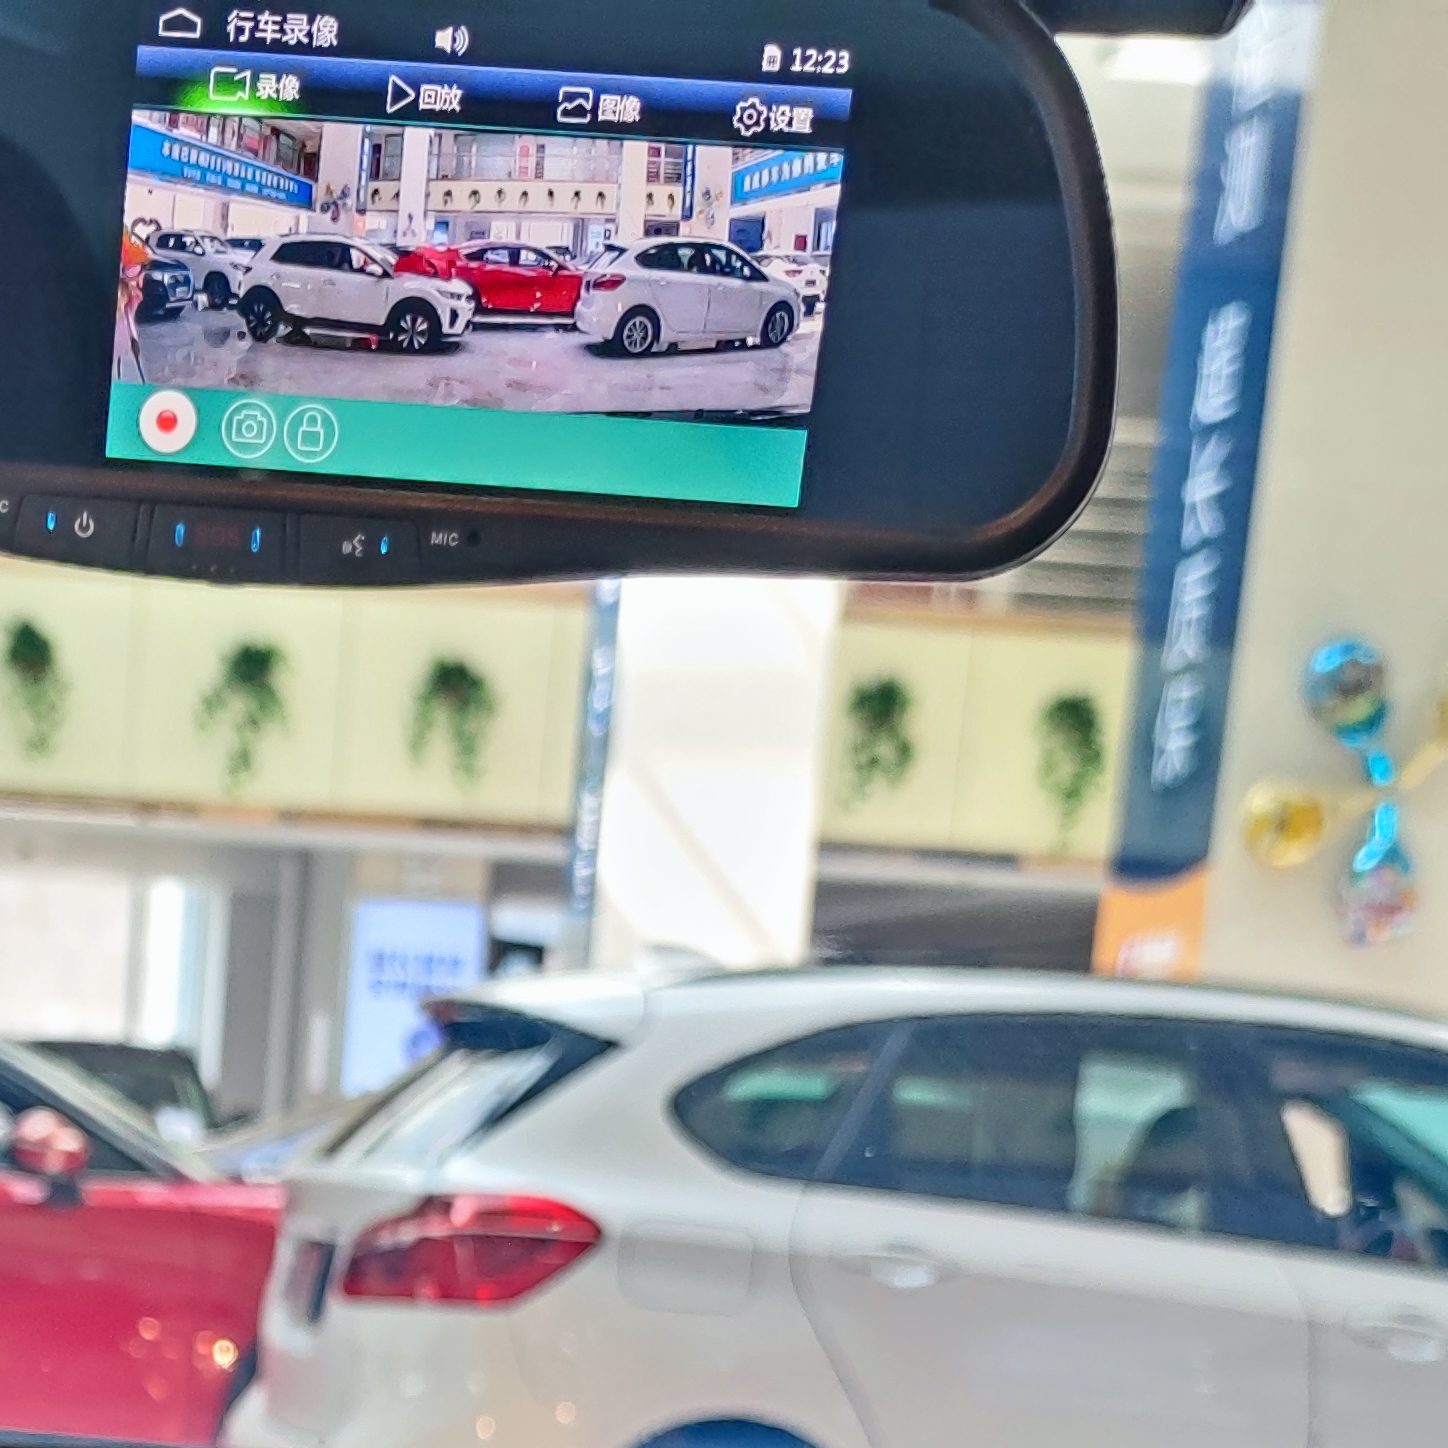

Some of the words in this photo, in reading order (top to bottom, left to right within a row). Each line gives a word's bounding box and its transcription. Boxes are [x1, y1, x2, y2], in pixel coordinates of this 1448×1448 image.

[226, 10, 339, 48] 行车录像
[790, 47, 851, 75] 12:23
[255, 73, 301, 102] 录像
[418, 83, 463, 113] 回放
[597, 93, 642, 123] 图像
[769, 105, 814, 134] 设置
[430, 531, 459, 547] MIC
